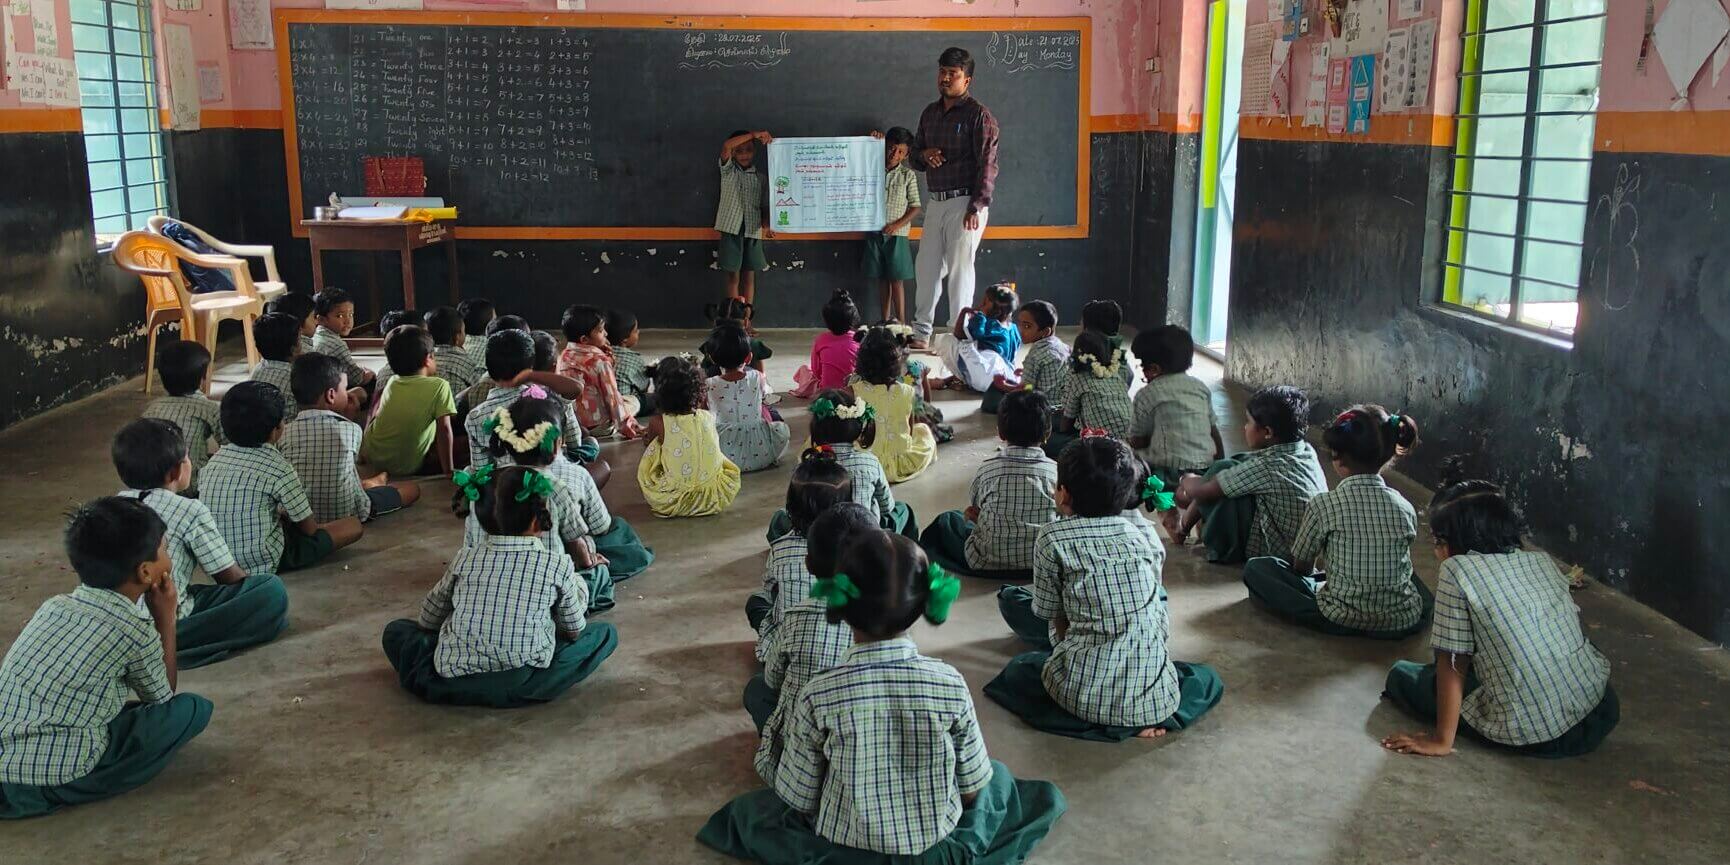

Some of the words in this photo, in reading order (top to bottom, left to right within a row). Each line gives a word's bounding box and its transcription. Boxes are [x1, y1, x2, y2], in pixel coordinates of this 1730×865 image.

[378, 30, 412, 48] Twenty
[380, 58, 414, 73] Twenty
[381, 70, 414, 87] Twenty
[380, 83, 413, 98] Twenty
[382, 95, 416, 111] Twenty
[383, 108, 418, 127] Twenty
